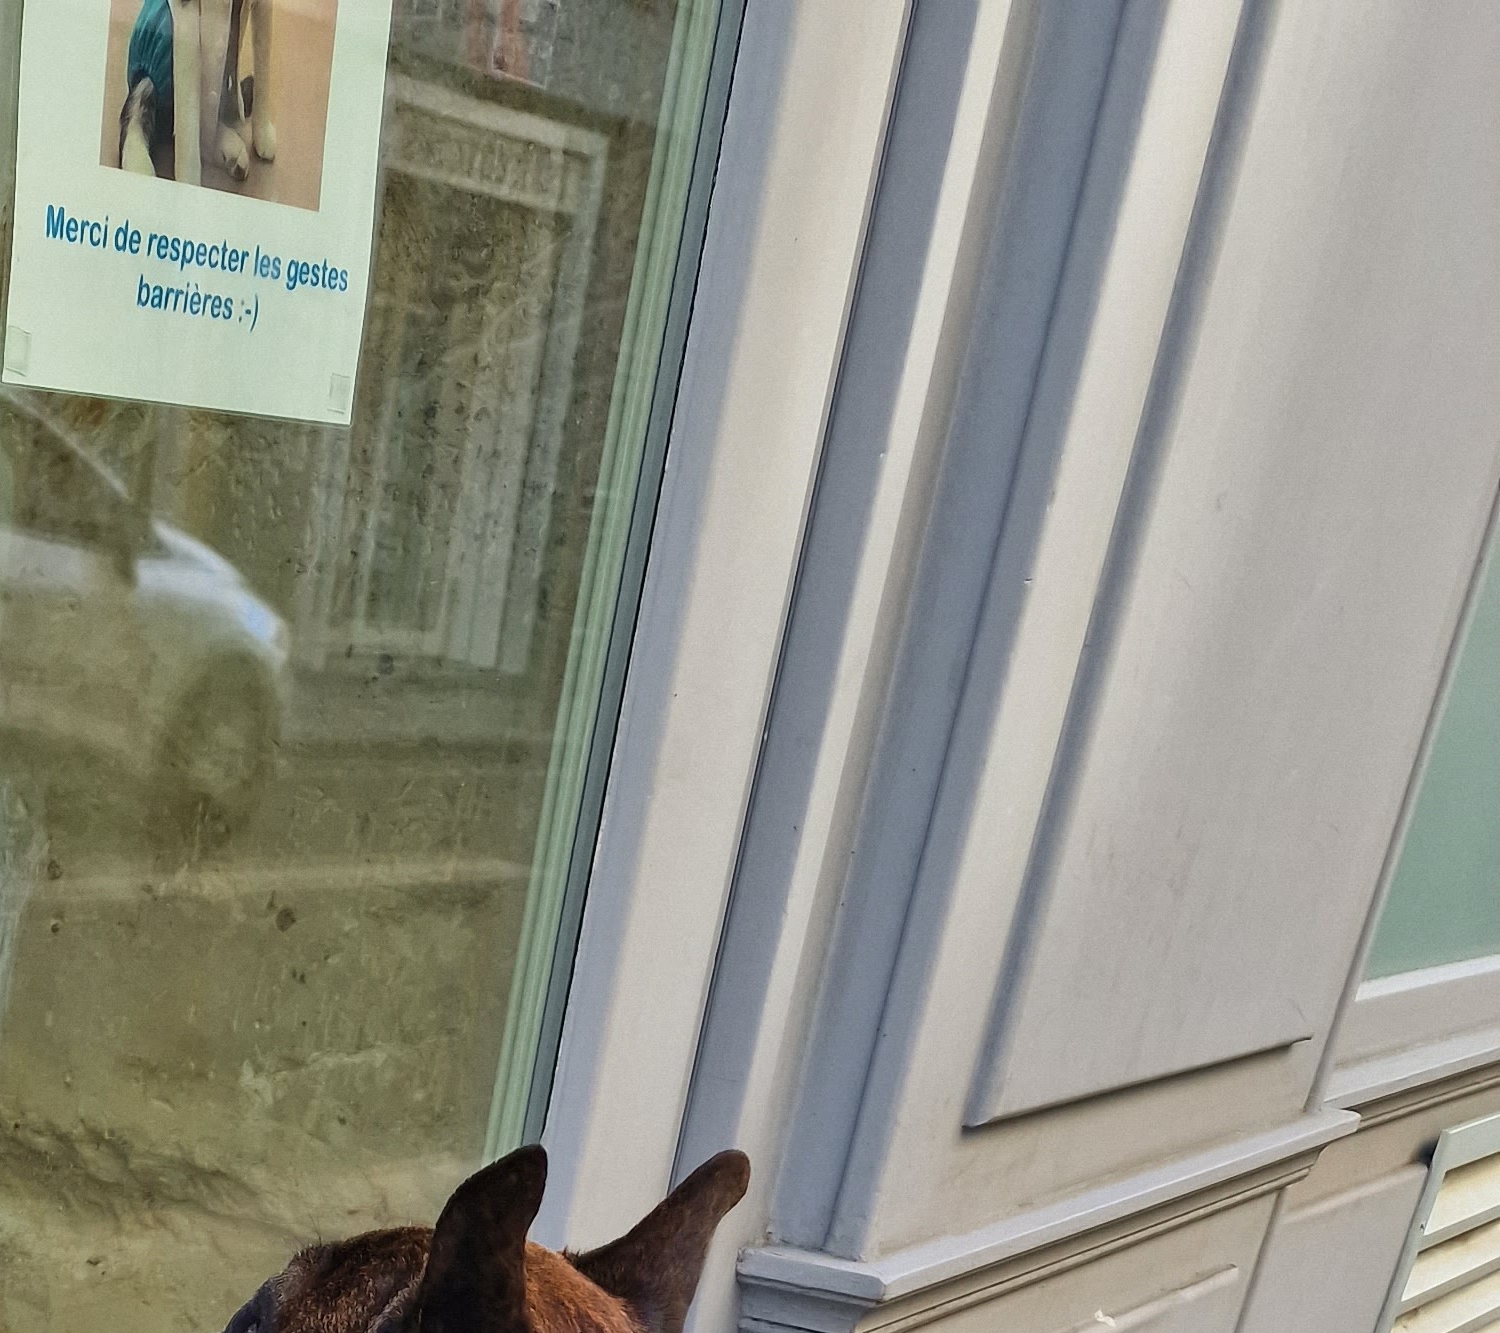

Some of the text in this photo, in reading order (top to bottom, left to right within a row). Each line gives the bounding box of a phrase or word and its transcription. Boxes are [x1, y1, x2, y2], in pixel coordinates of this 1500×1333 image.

[46, 204, 349, 292] Merci de respecter les gestes
[137, 273, 234, 321] barrières
